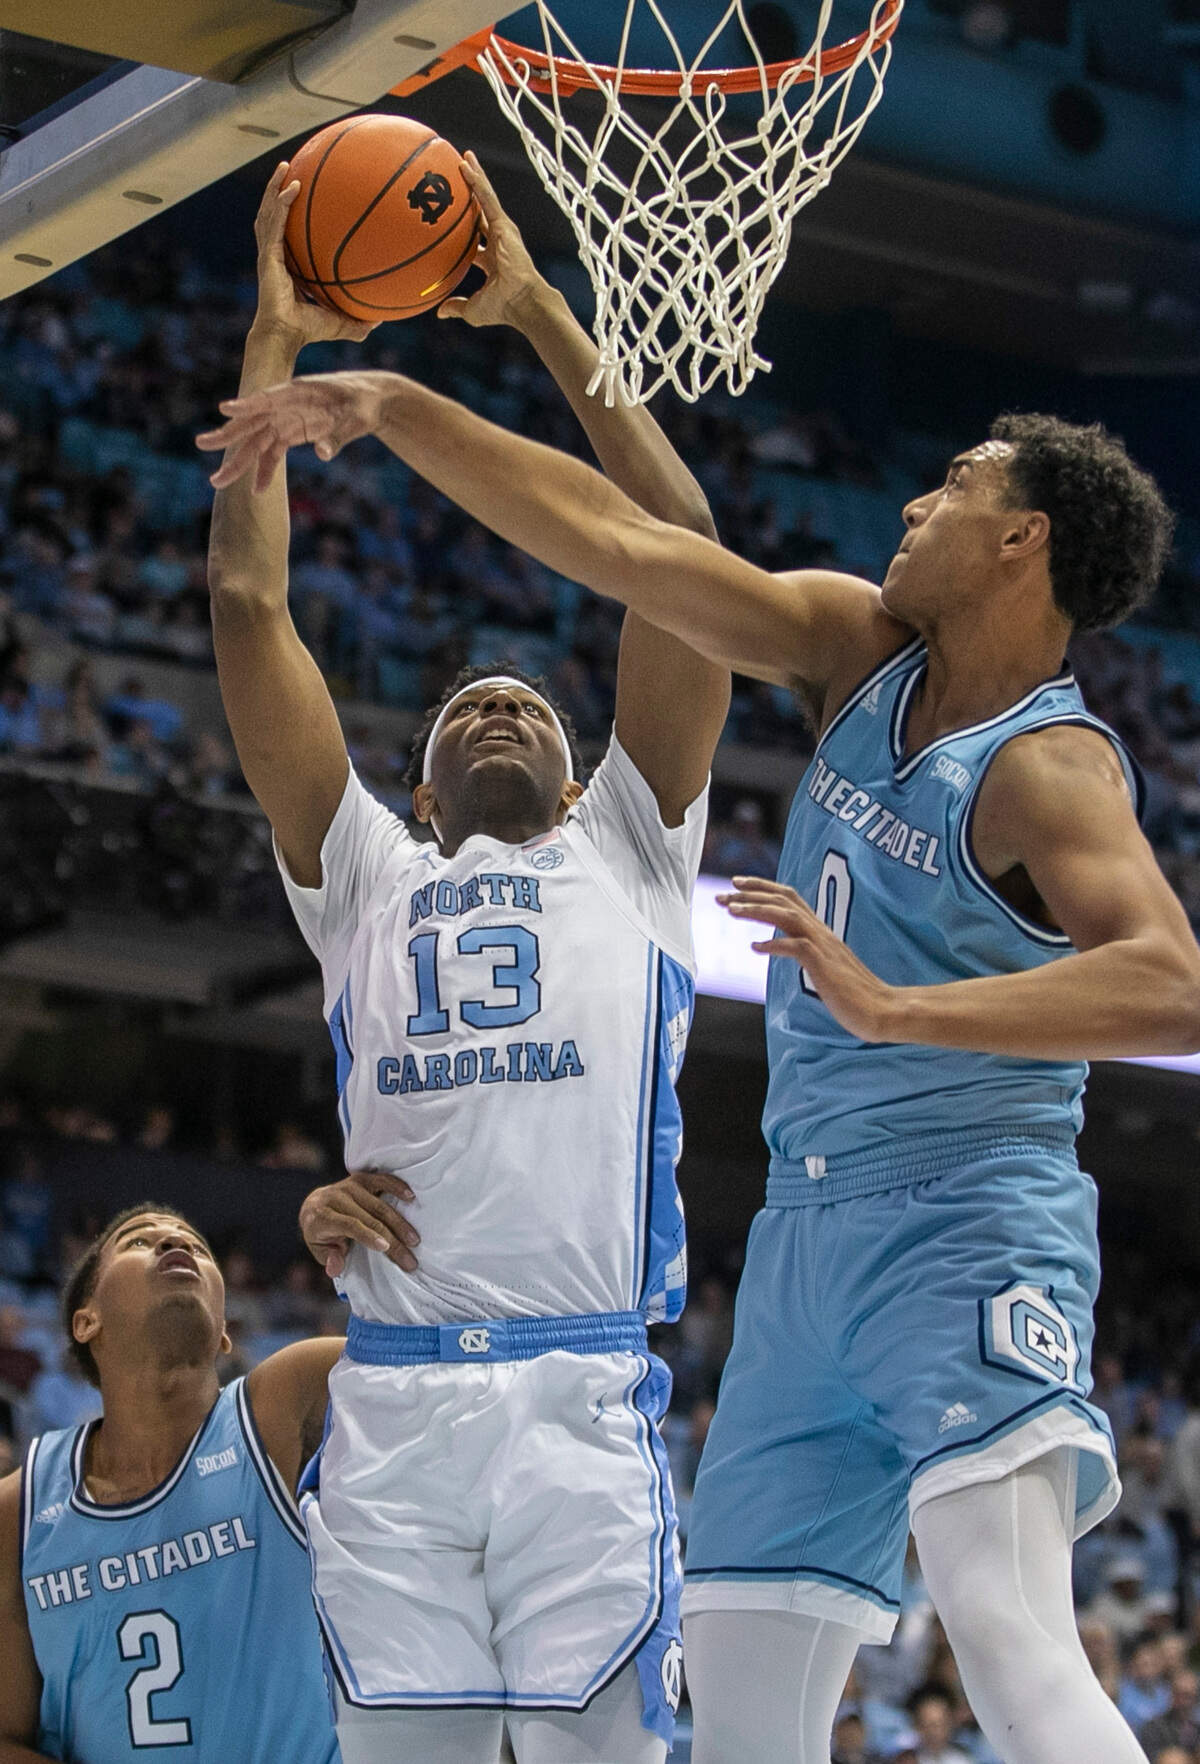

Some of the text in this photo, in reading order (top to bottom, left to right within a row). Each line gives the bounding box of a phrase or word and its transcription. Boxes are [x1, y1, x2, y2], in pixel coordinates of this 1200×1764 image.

[837, 789, 941, 878] CITADEL
[409, 873, 542, 929] NORTH
[406, 924, 541, 1037] 13
[377, 1040, 585, 1096] CAROLINA
[938, 1412, 978, 1434] adidas
[195, 1446, 238, 1477] SOCON
[28, 1516, 257, 1611] THE CITADEL
[116, 1608, 193, 1750] 2
